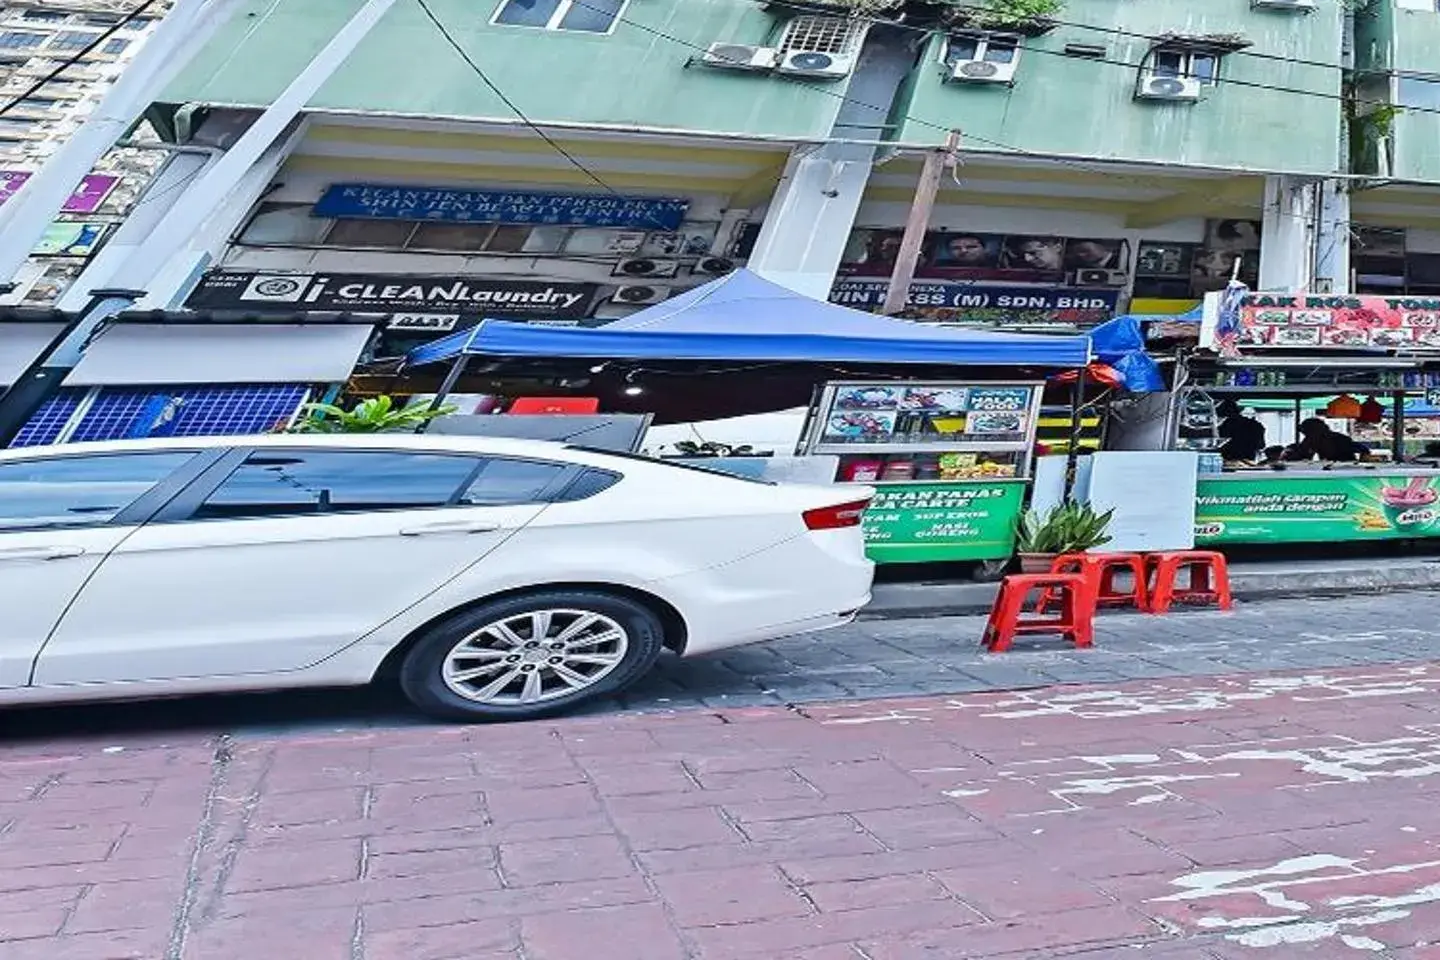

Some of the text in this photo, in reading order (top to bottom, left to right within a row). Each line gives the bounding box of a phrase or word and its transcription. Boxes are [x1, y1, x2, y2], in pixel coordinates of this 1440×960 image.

[1056, 296, 1111, 309] BHD.
[971, 396, 1023, 404] HALAL
[974, 402, 1019, 410] FOOD
[900, 498, 971, 509] CARTE
